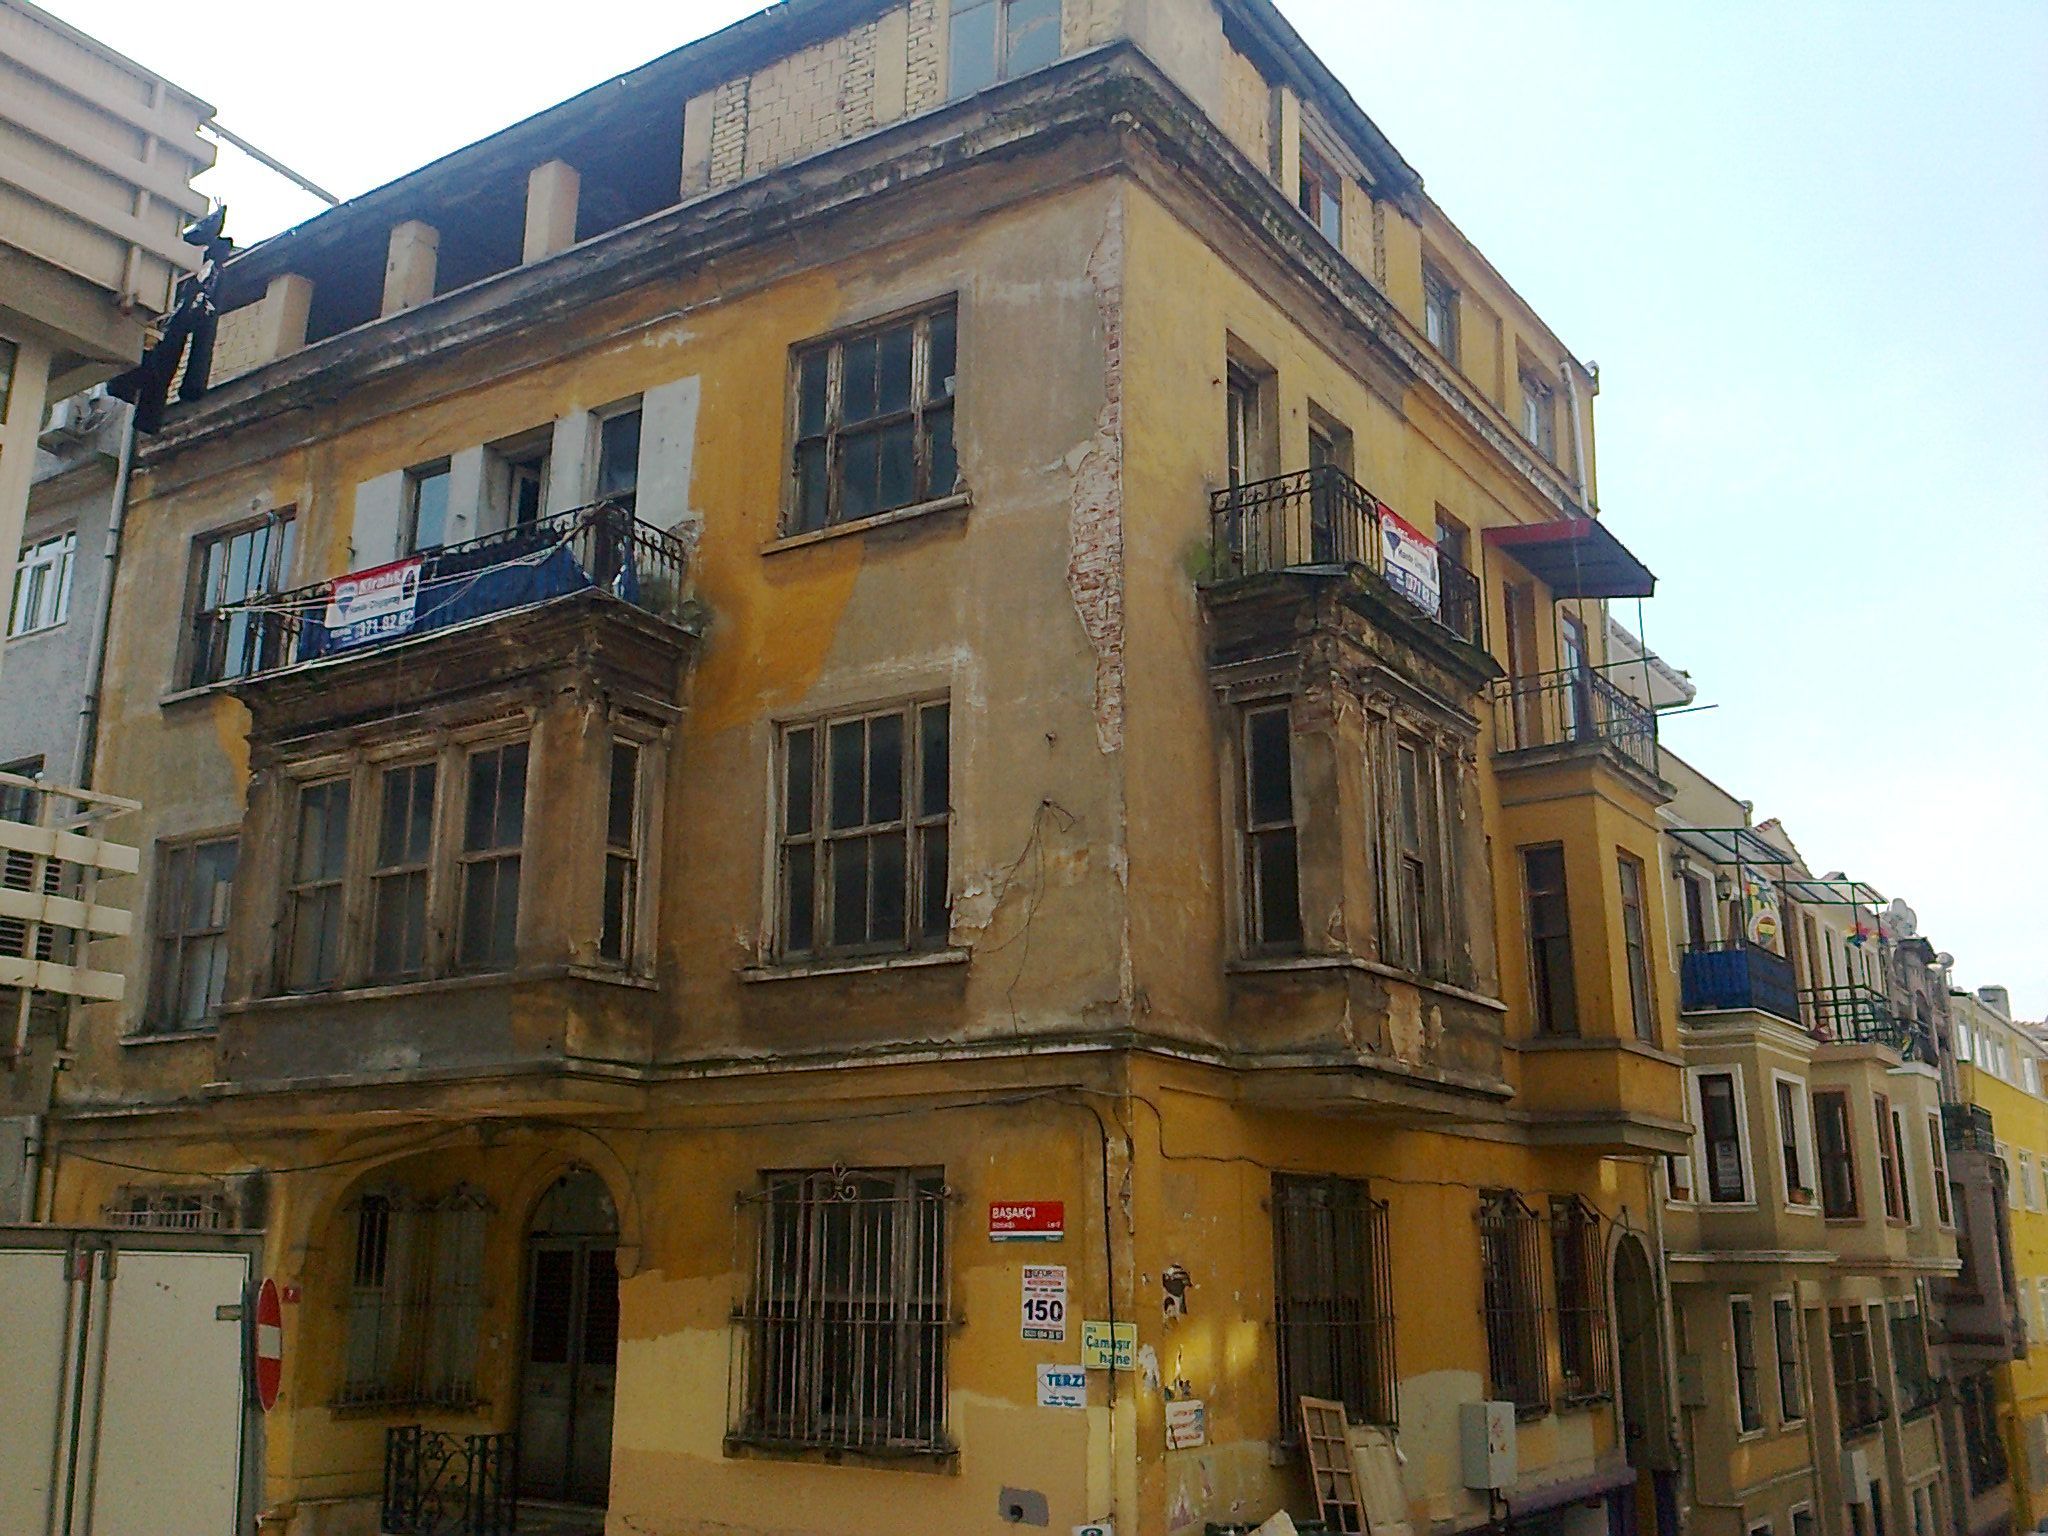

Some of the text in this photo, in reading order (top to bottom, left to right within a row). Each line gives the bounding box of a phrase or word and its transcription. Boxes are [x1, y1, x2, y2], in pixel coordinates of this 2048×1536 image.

[992, 1206, 1037, 1220] BAŞAKÇI
[1023, 1299, 1063, 1321] 150
[1086, 1335, 1131, 1351] Çamşır
